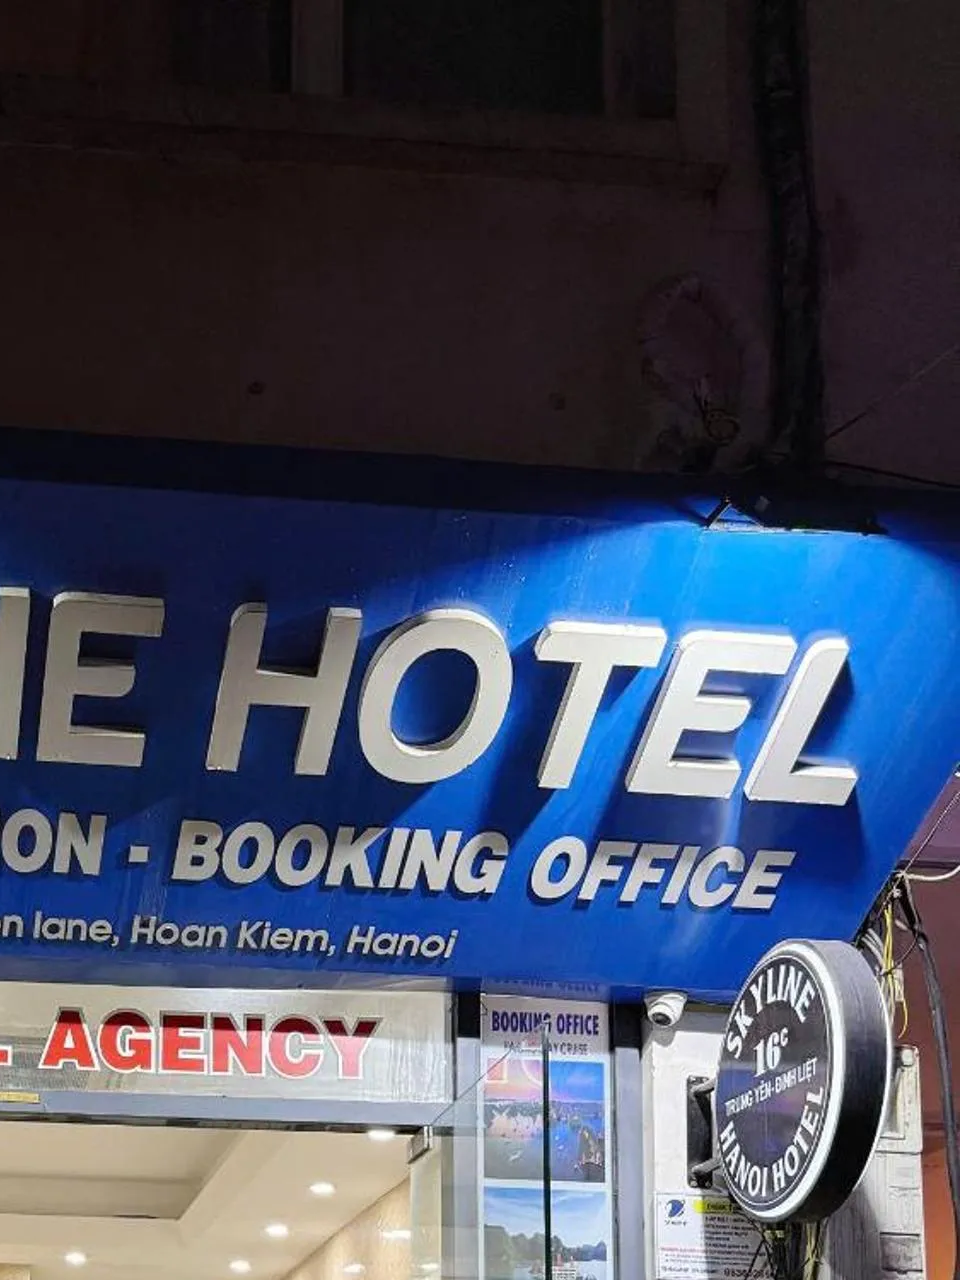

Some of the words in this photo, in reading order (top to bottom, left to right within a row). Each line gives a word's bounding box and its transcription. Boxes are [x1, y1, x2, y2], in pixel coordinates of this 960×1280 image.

[205, 602, 859, 806] HOTEL
[171, 820, 509, 897] BOOKING
[530, 838, 795, 910] OFFICE
[33, 911, 120, 946] lane,
[130, 915, 228, 948] Hoan
[238, 920, 335, 955] Kiem,
[347, 925, 459, 960] Hanoi
[39, 1006, 382, 1080] AGENCY
[492, 1010, 552, 1033] BOOKING
[556, 1013, 599, 1036] OFFICE
[727, 963, 818, 1059] SKYLINE
[720, 1120, 768, 1198] HANOI
[773, 1086, 825, 1193] HOTEL
[724, 1090, 753, 1117] TRUNG
